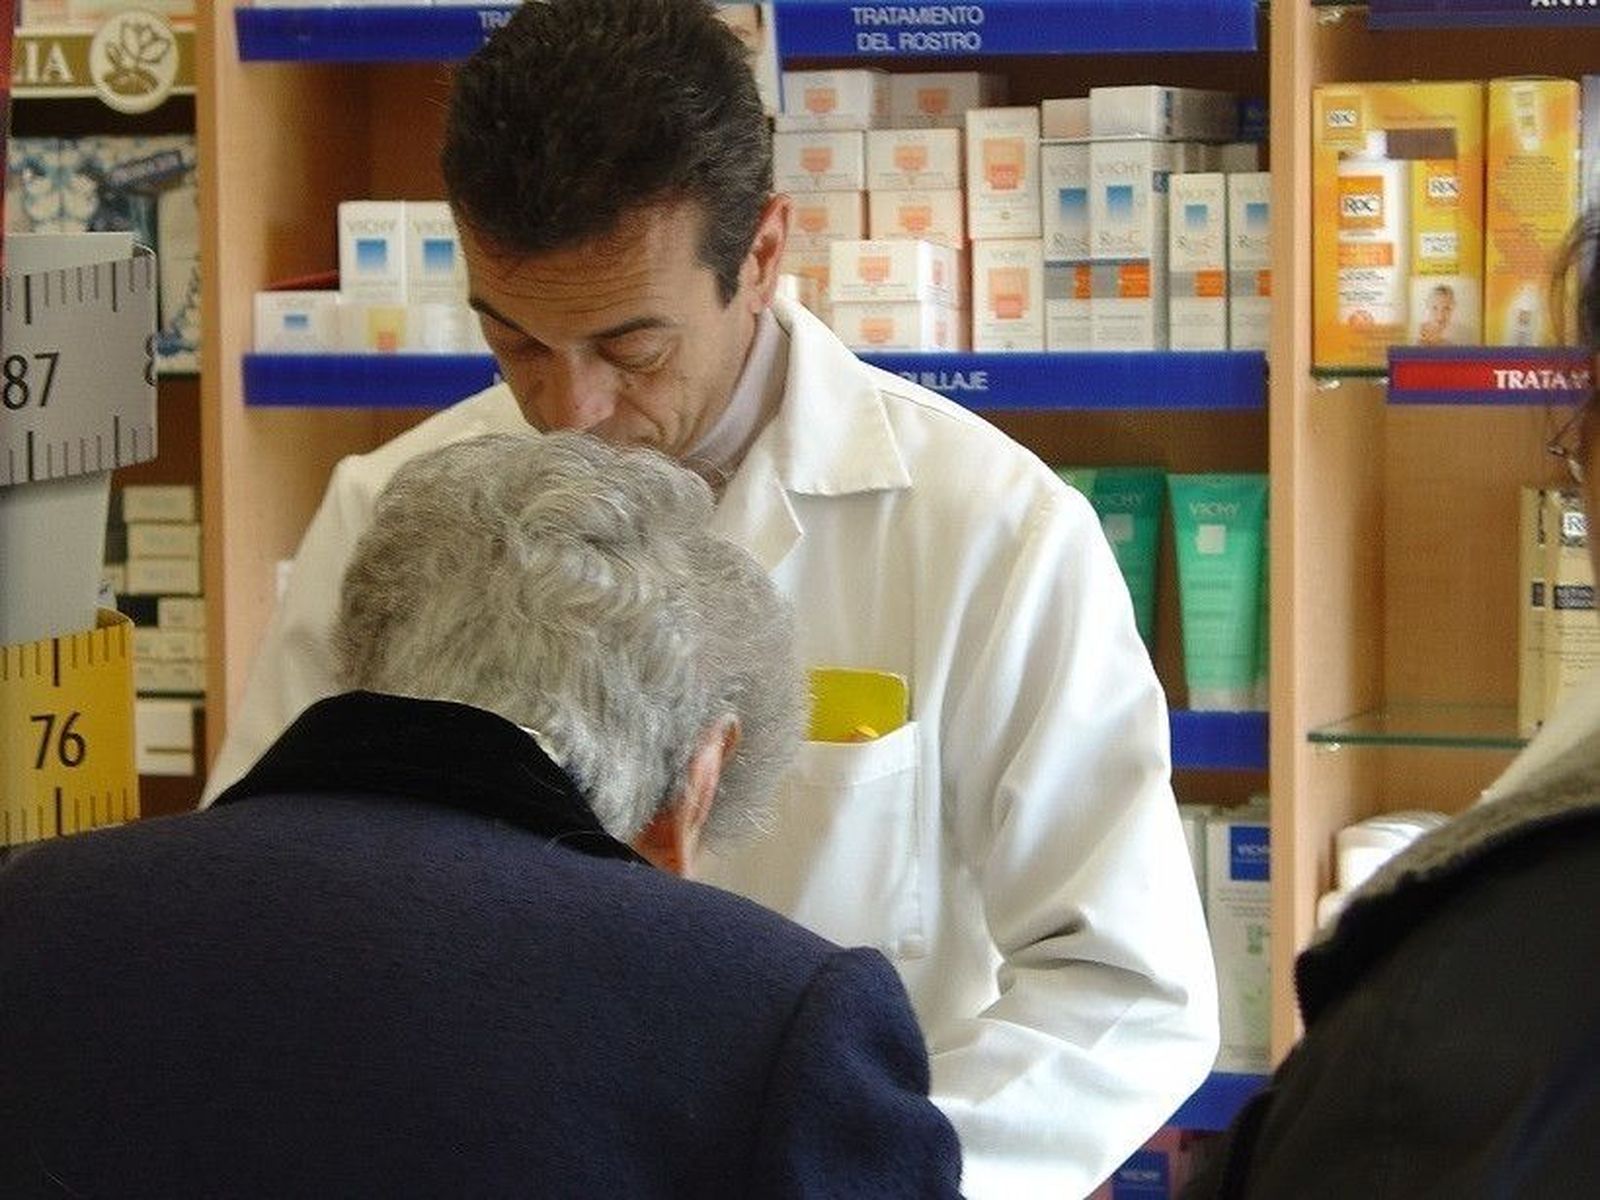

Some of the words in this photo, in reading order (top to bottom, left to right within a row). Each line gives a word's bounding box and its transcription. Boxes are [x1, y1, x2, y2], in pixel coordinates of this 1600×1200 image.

[851, 5, 984, 25] TRATAMIENTO
[857, 31, 896, 51] DEL
[899, 30, 981, 51] ROSTRO
[13, 41, 74, 82] IA
[3, 352, 59, 410] 87
[1189, 499, 1241, 519] VICHY
[30, 711, 85, 770] 76
